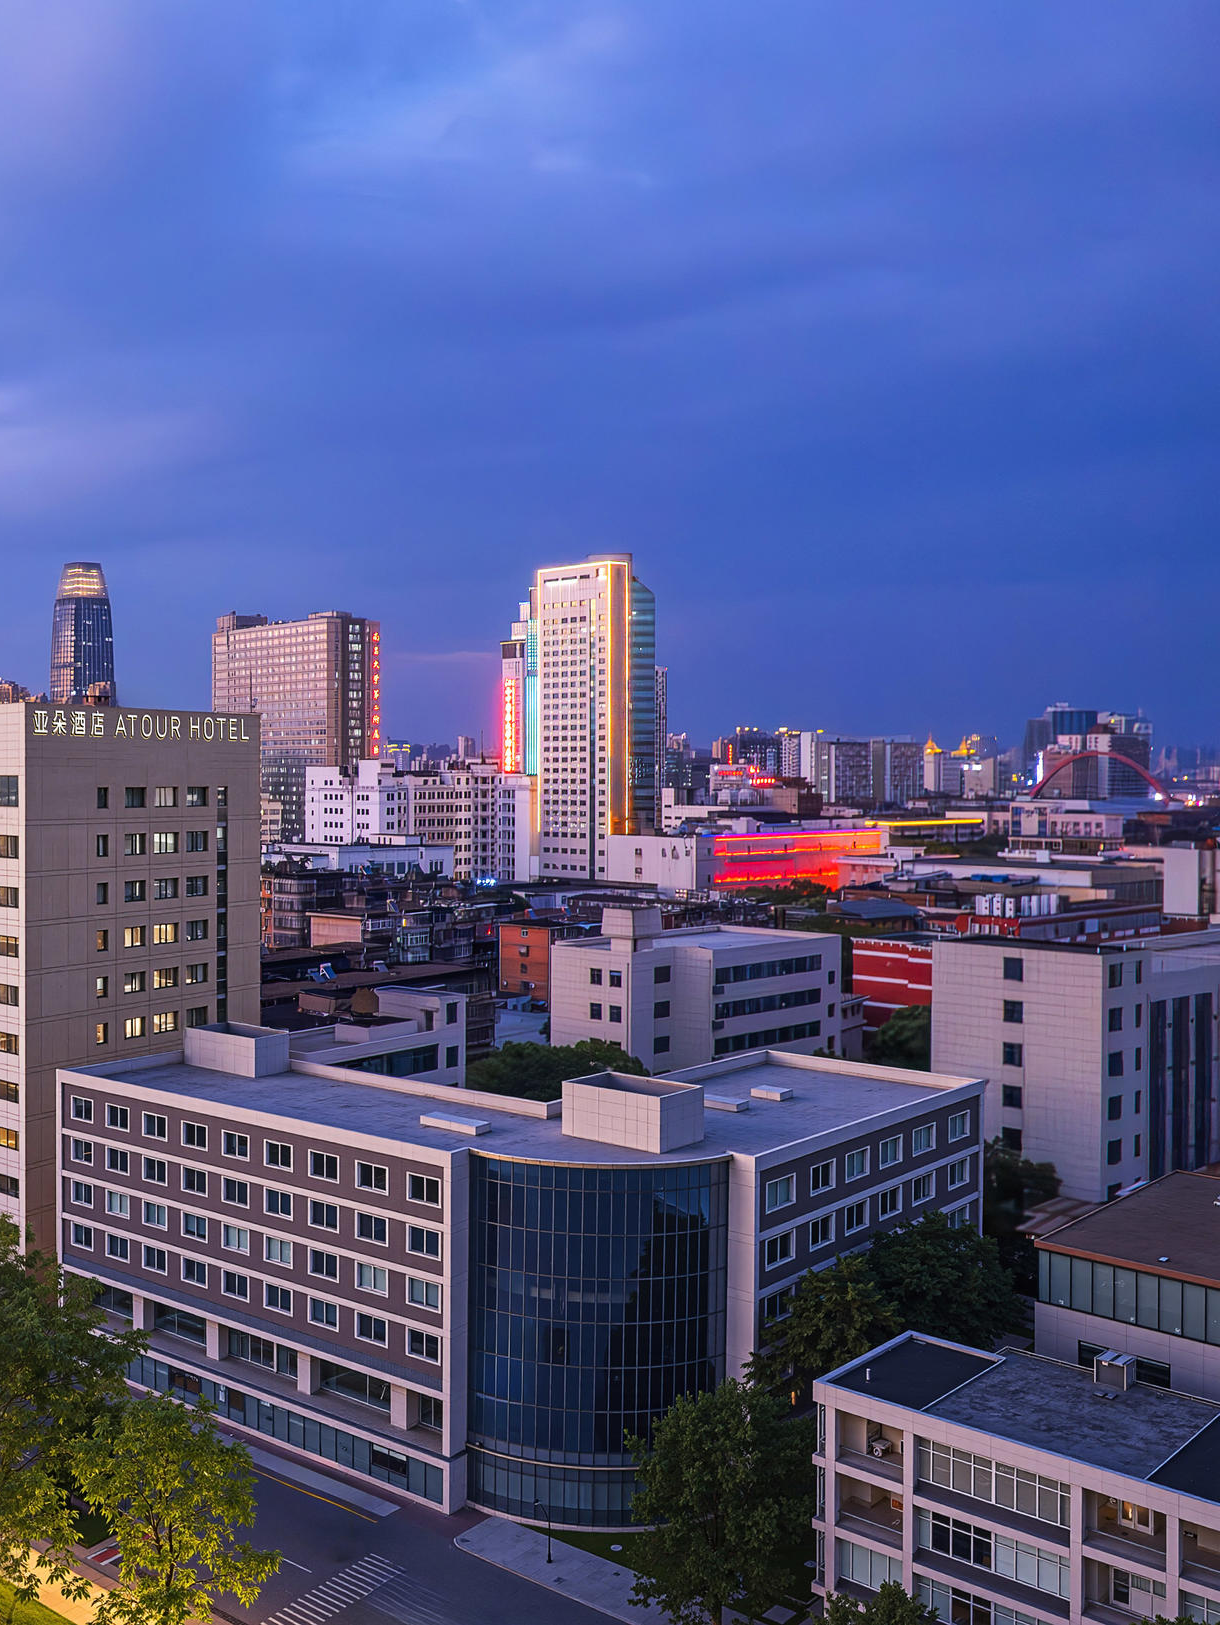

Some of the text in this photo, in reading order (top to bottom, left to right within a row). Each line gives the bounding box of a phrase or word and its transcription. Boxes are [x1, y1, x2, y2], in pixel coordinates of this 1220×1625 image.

[33, 709, 250, 742] 亚朵酒店 ATOUR HOTEL
